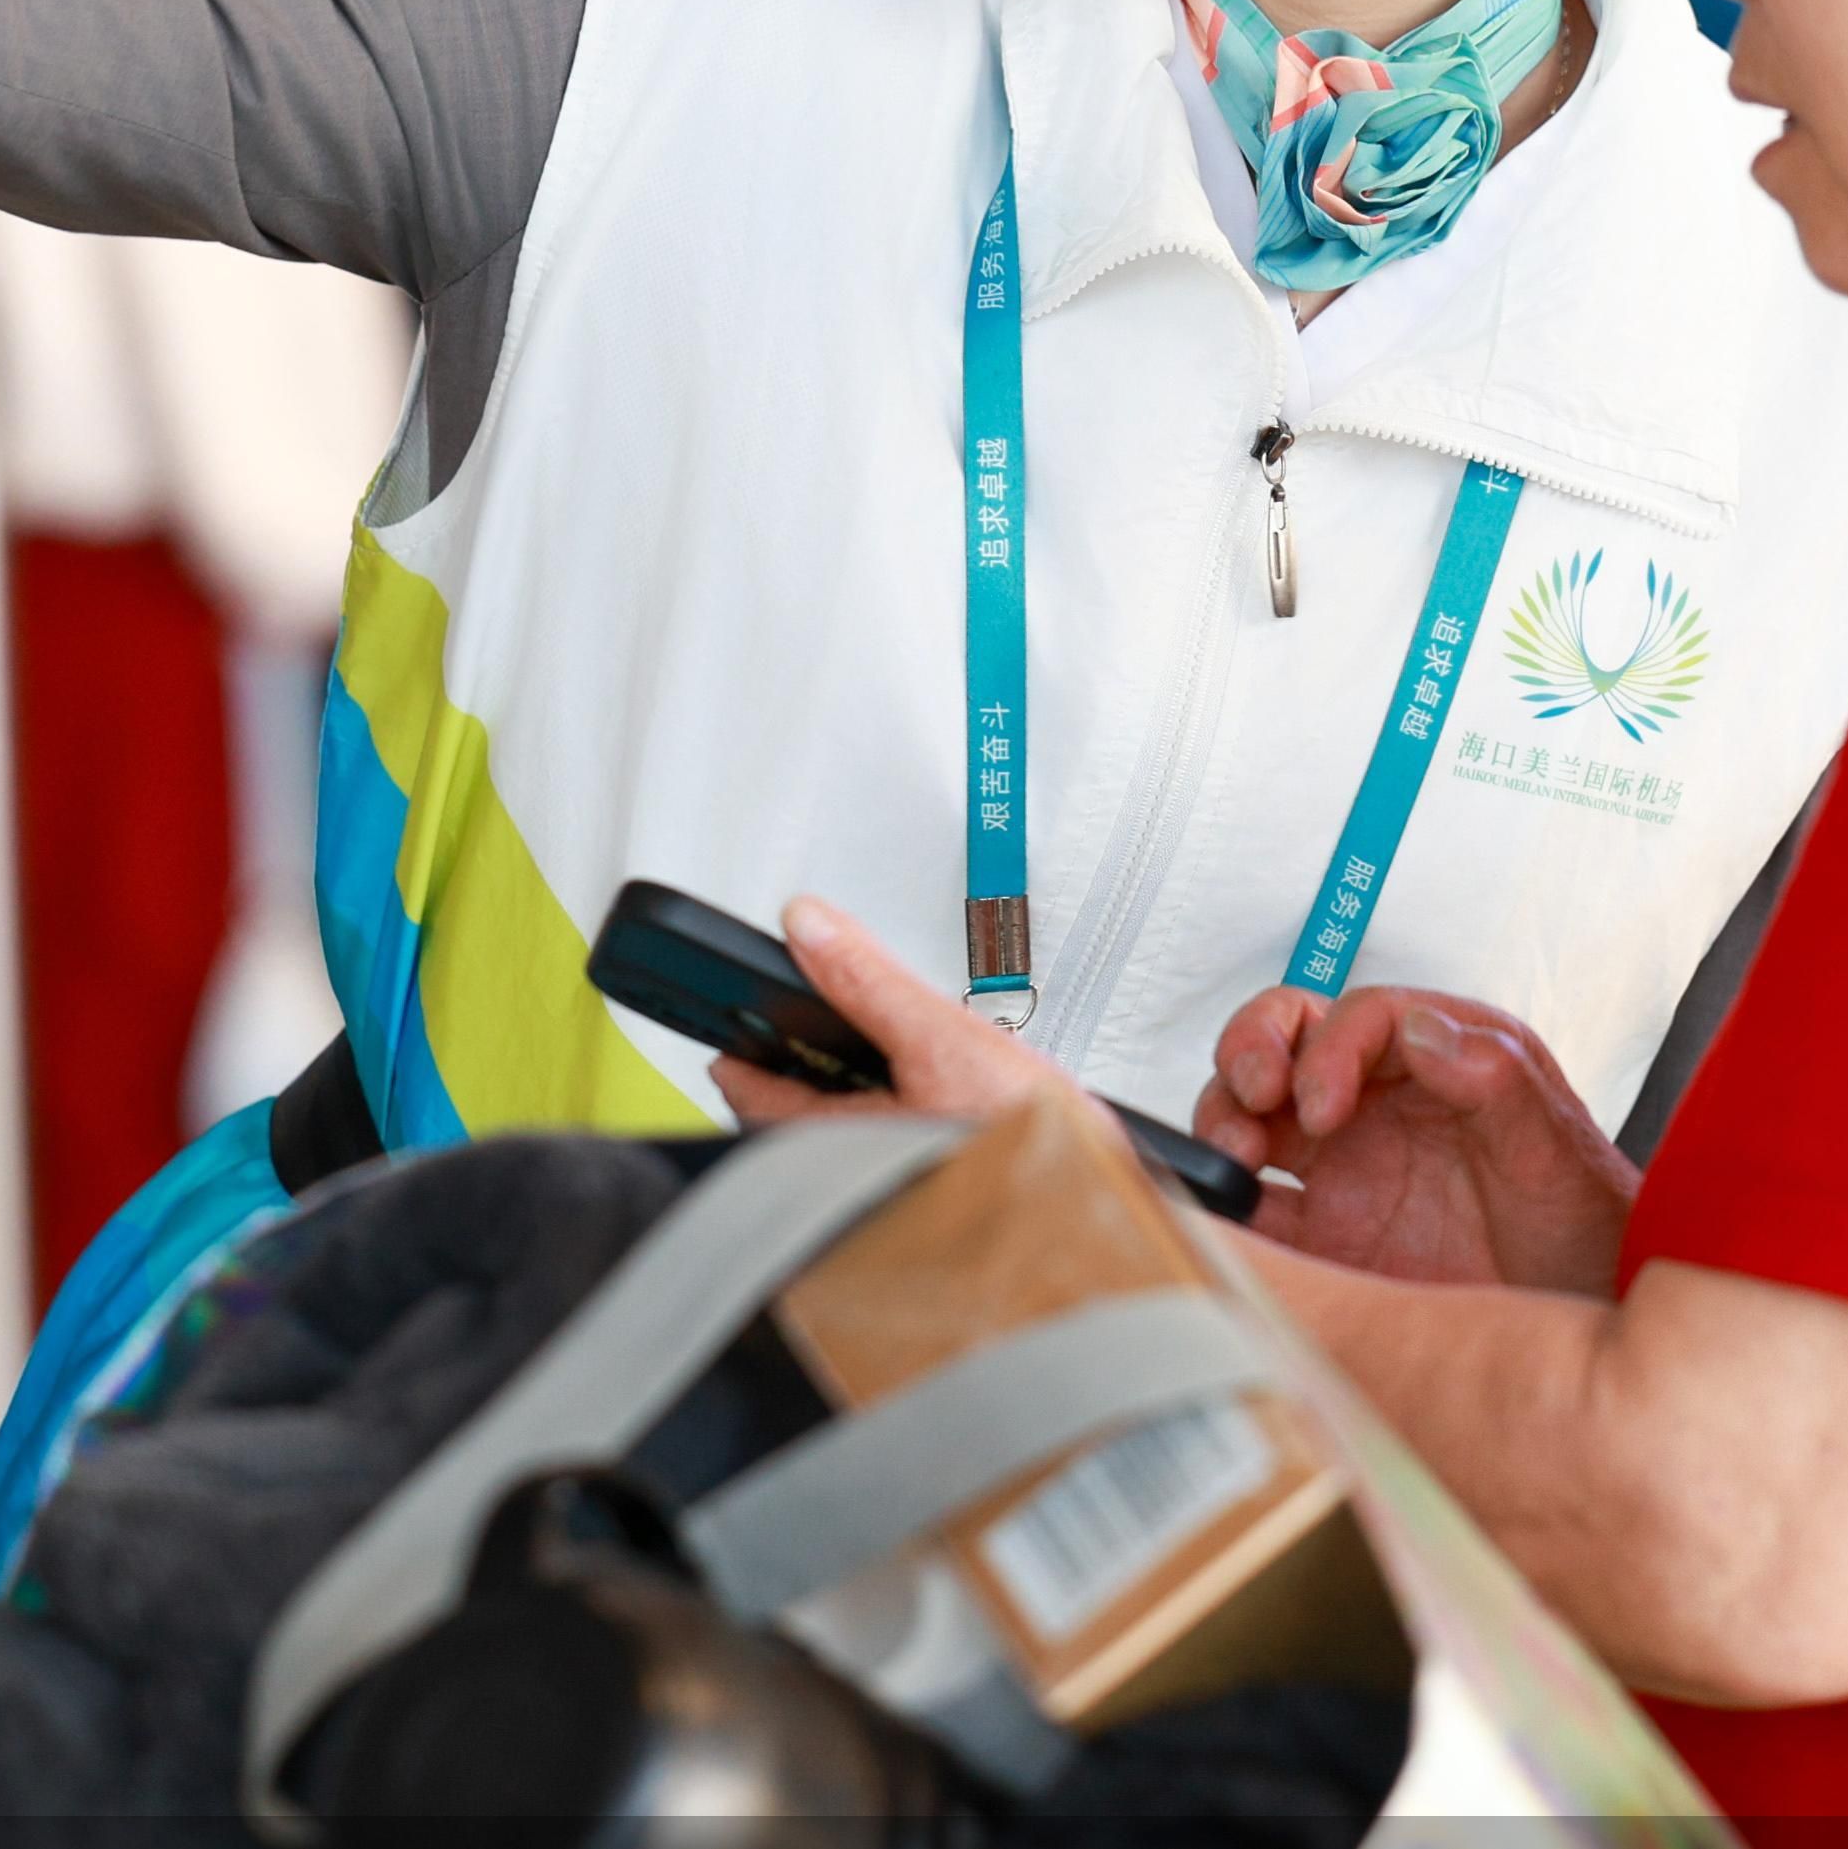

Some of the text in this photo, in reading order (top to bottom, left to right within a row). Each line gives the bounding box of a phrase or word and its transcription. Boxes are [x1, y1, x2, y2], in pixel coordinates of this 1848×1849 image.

[977, 438, 1010, 568] 追求卓越
[1399, 612, 1466, 741] 追求卓越
[979, 702, 1010, 832] 艰苦奋斗
[1453, 765, 1675, 826] HAIKOU MEILAN INTERNATIONAL AIRPORT
[1457, 730, 1685, 810] 海口美兰国际机场
[1304, 855, 1376, 985] 服务海南
